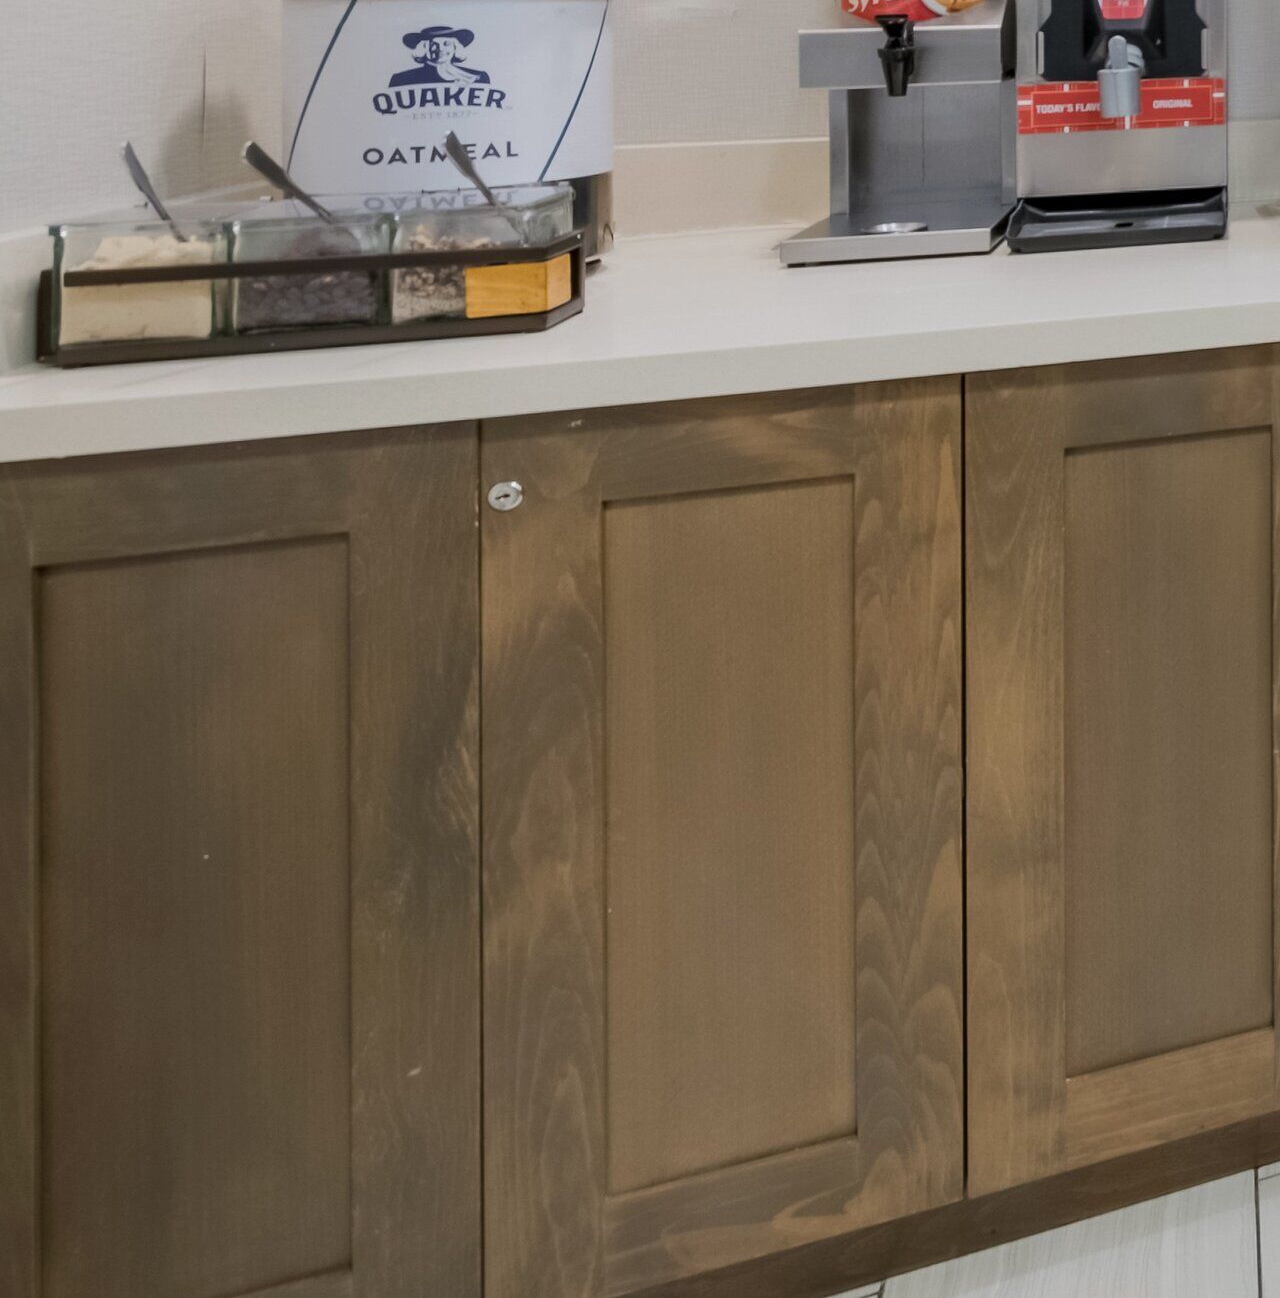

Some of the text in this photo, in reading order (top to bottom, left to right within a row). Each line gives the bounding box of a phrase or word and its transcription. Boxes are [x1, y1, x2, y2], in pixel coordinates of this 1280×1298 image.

[372, 86, 507, 116] QUAKER
[1152, 98, 1193, 110] ORIGINAL
[1035, 103, 1074, 115] TODAY'S
